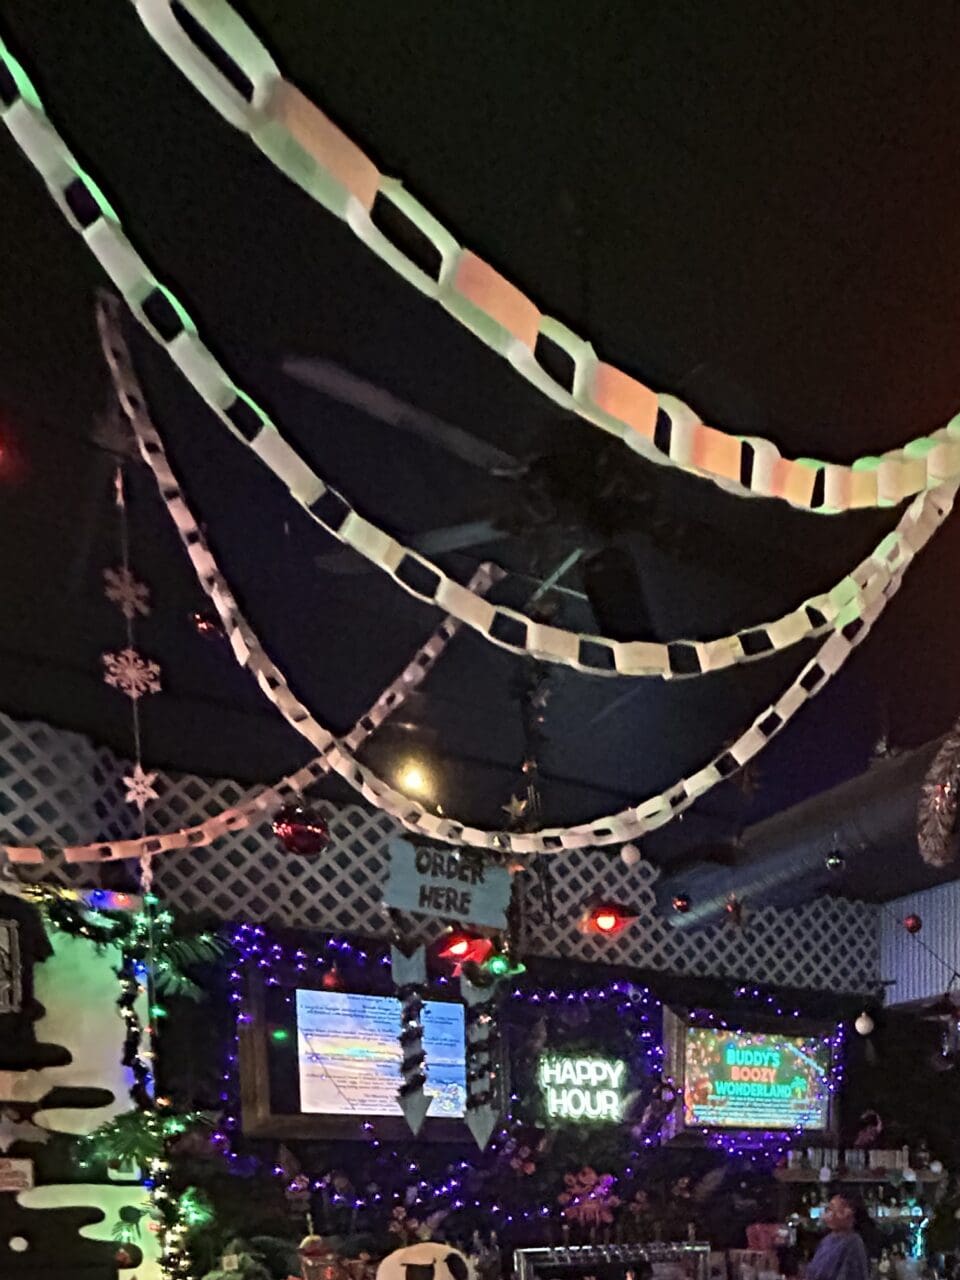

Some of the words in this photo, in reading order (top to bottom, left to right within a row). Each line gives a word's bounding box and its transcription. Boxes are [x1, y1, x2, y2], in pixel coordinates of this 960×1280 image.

[416, 845, 485, 884] ORDER
[419, 885, 472, 915] HERE
[726, 1045, 780, 1067] BUDDY'S
[542, 1058, 625, 1089] HAPPY
[731, 1067, 777, 1083] BOOZY
[549, 1088, 621, 1121] HOUR
[715, 1081, 791, 1098] WONDERLAND
